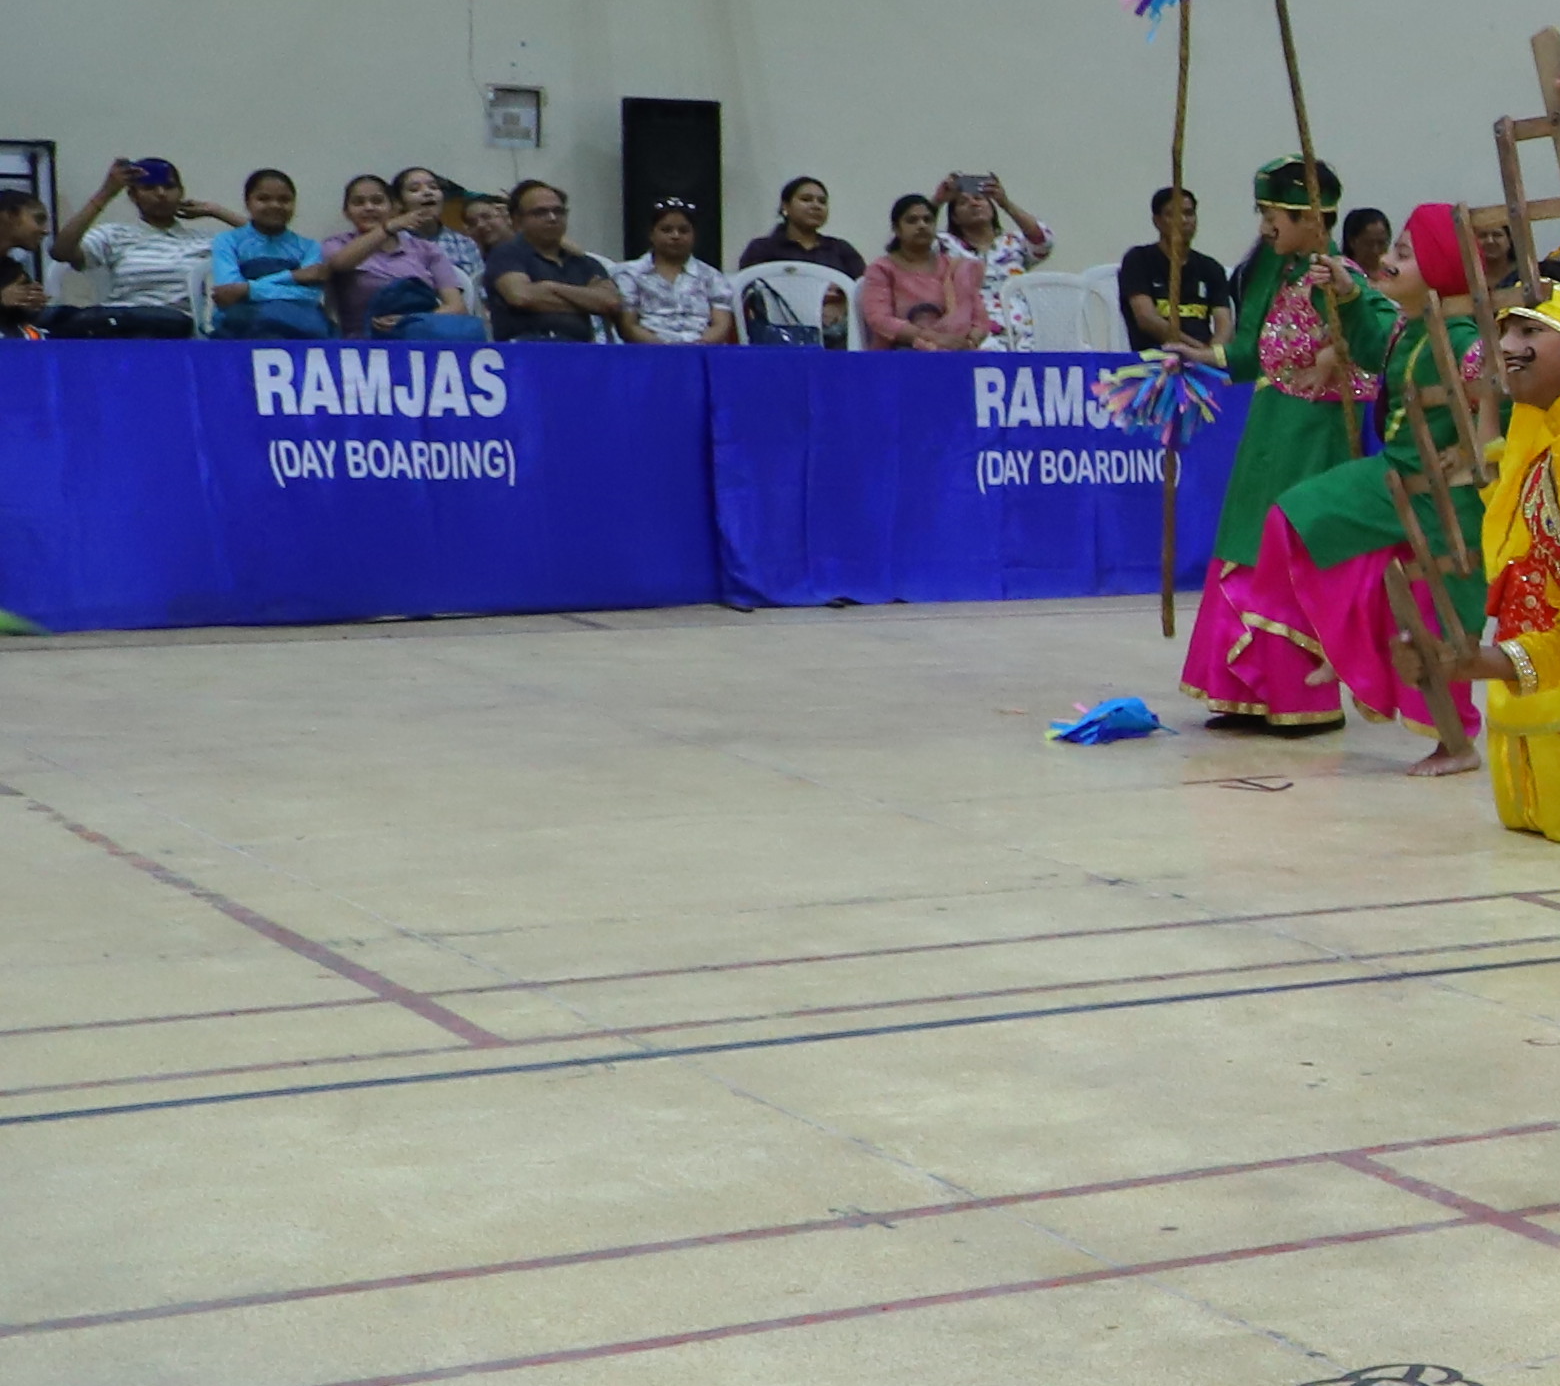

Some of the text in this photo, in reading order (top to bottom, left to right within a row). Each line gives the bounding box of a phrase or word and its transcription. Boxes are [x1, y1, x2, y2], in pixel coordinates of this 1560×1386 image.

[252, 347, 508, 418] RAMJAS
[269, 439, 516, 488] (DAY BOARDING)
[976, 450, 1034, 495] (DAY
